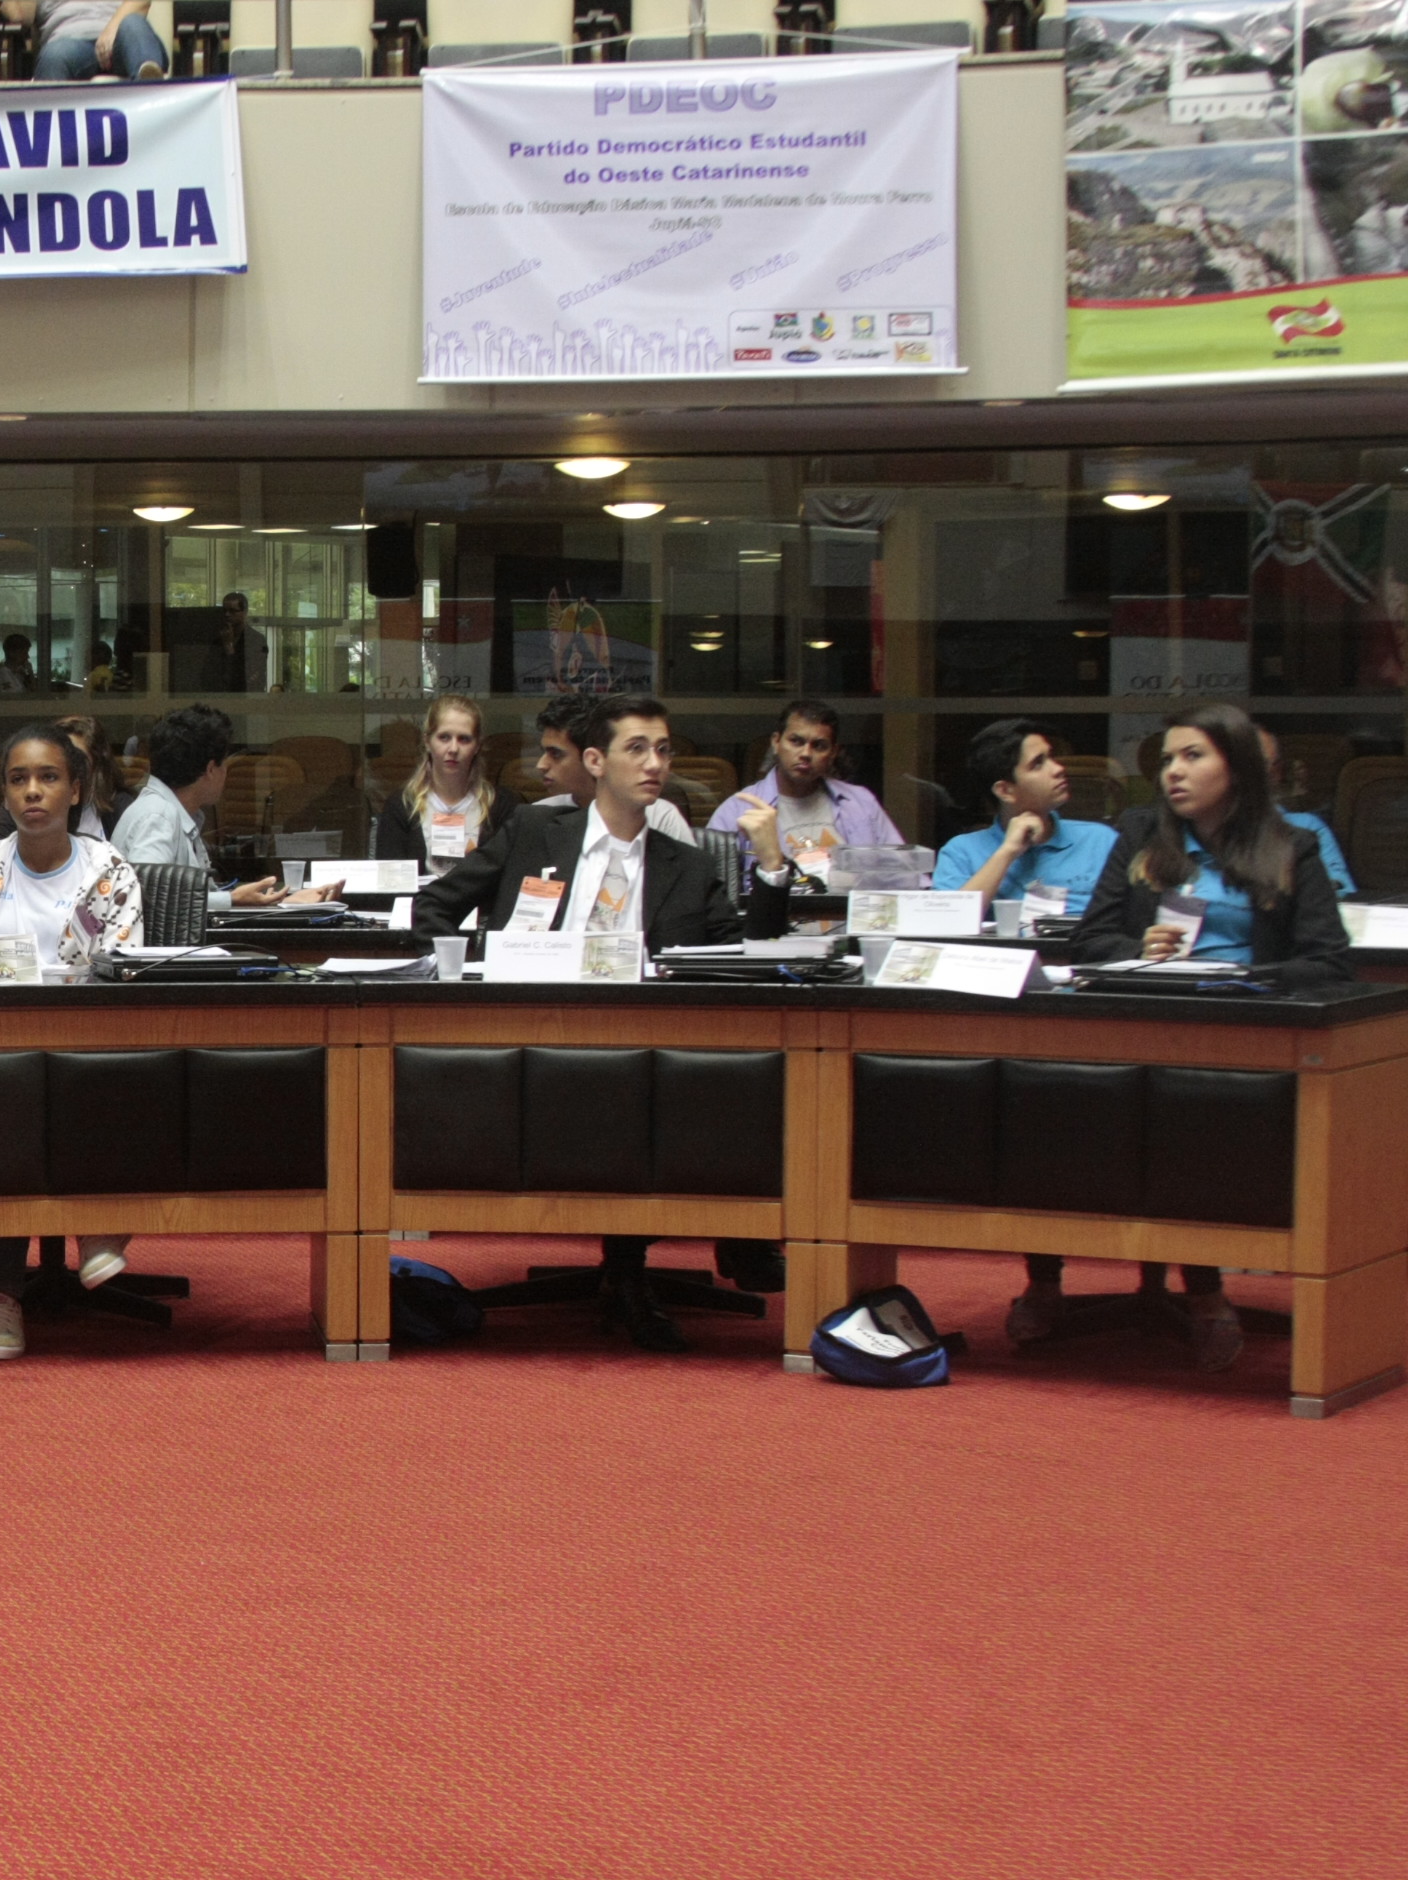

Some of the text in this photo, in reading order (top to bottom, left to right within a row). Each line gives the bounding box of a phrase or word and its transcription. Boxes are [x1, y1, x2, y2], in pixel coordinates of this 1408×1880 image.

[593, 76, 778, 117] PDEOC
[509, 130, 867, 159] Partido Democrático Estudantil
[563, 162, 810, 185] do Oeste Catarinense
